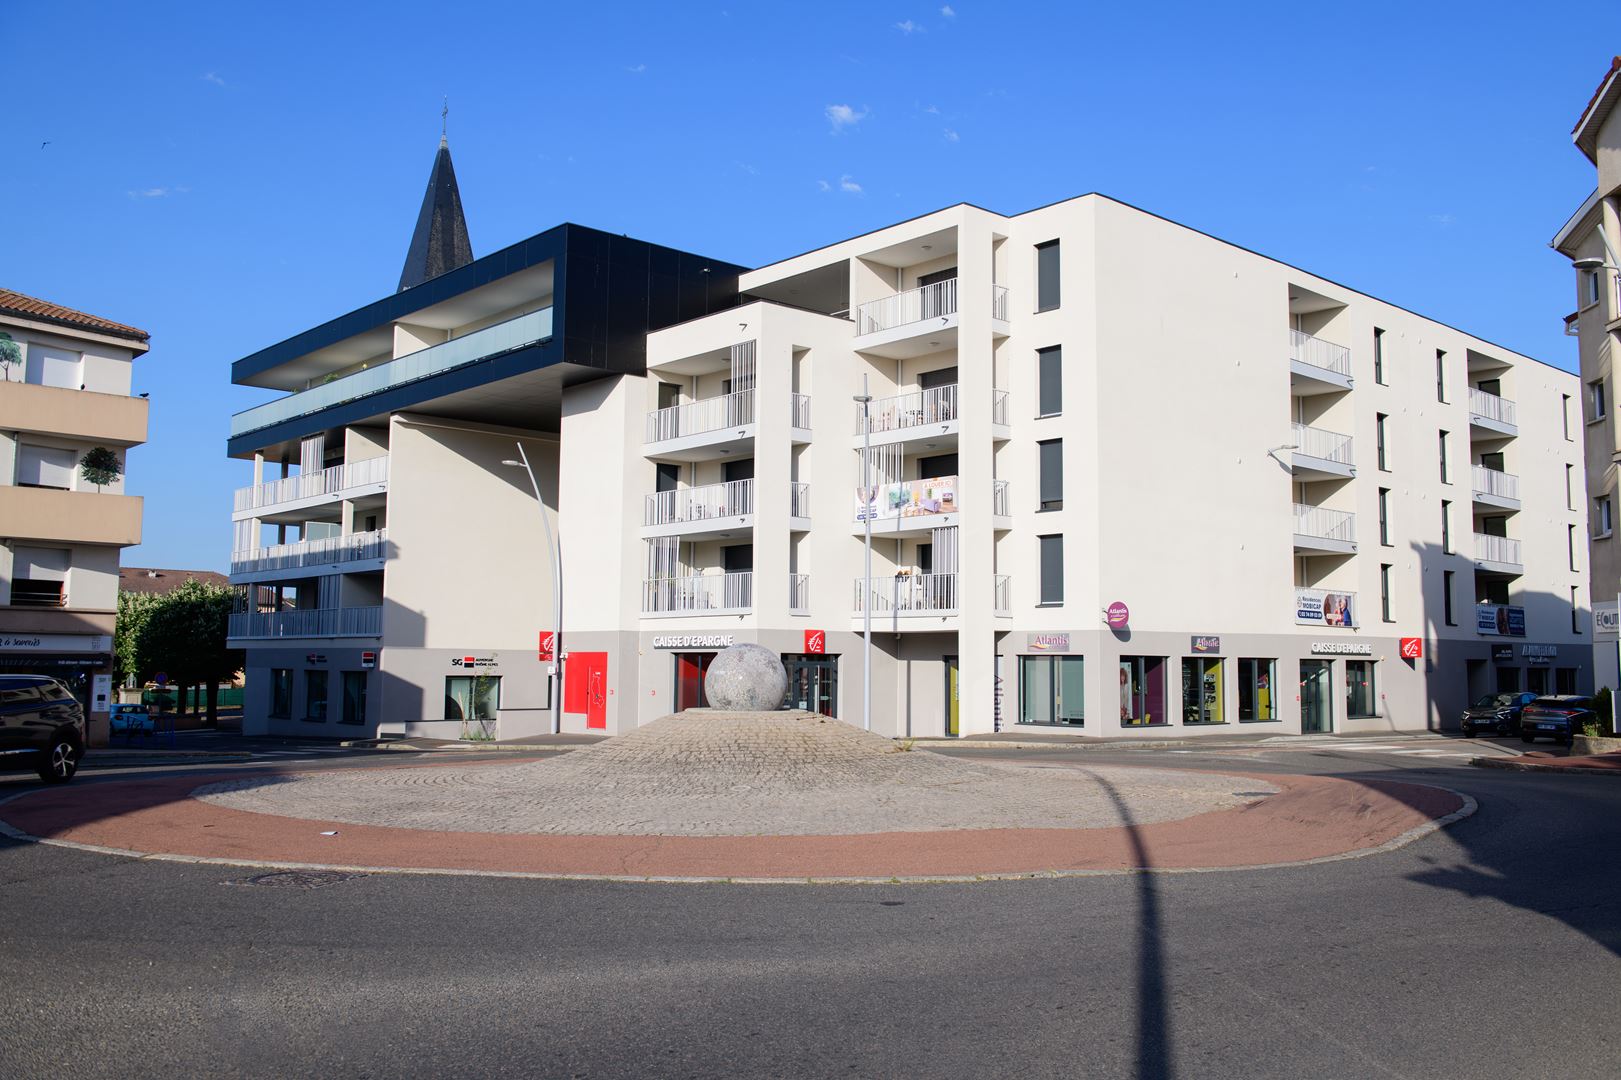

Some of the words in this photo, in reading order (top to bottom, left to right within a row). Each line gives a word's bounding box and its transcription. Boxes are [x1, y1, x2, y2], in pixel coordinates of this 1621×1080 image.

[653, 636, 682, 647] CAISSE
[684, 635, 733, 646] D'EPARGNE
[1035, 635, 1067, 645] Atlantis
[1312, 642, 1336, 652] CAISSE
[1337, 643, 1372, 654] D'EPARGNE
[993, 675, 1004, 732] Atlantis
